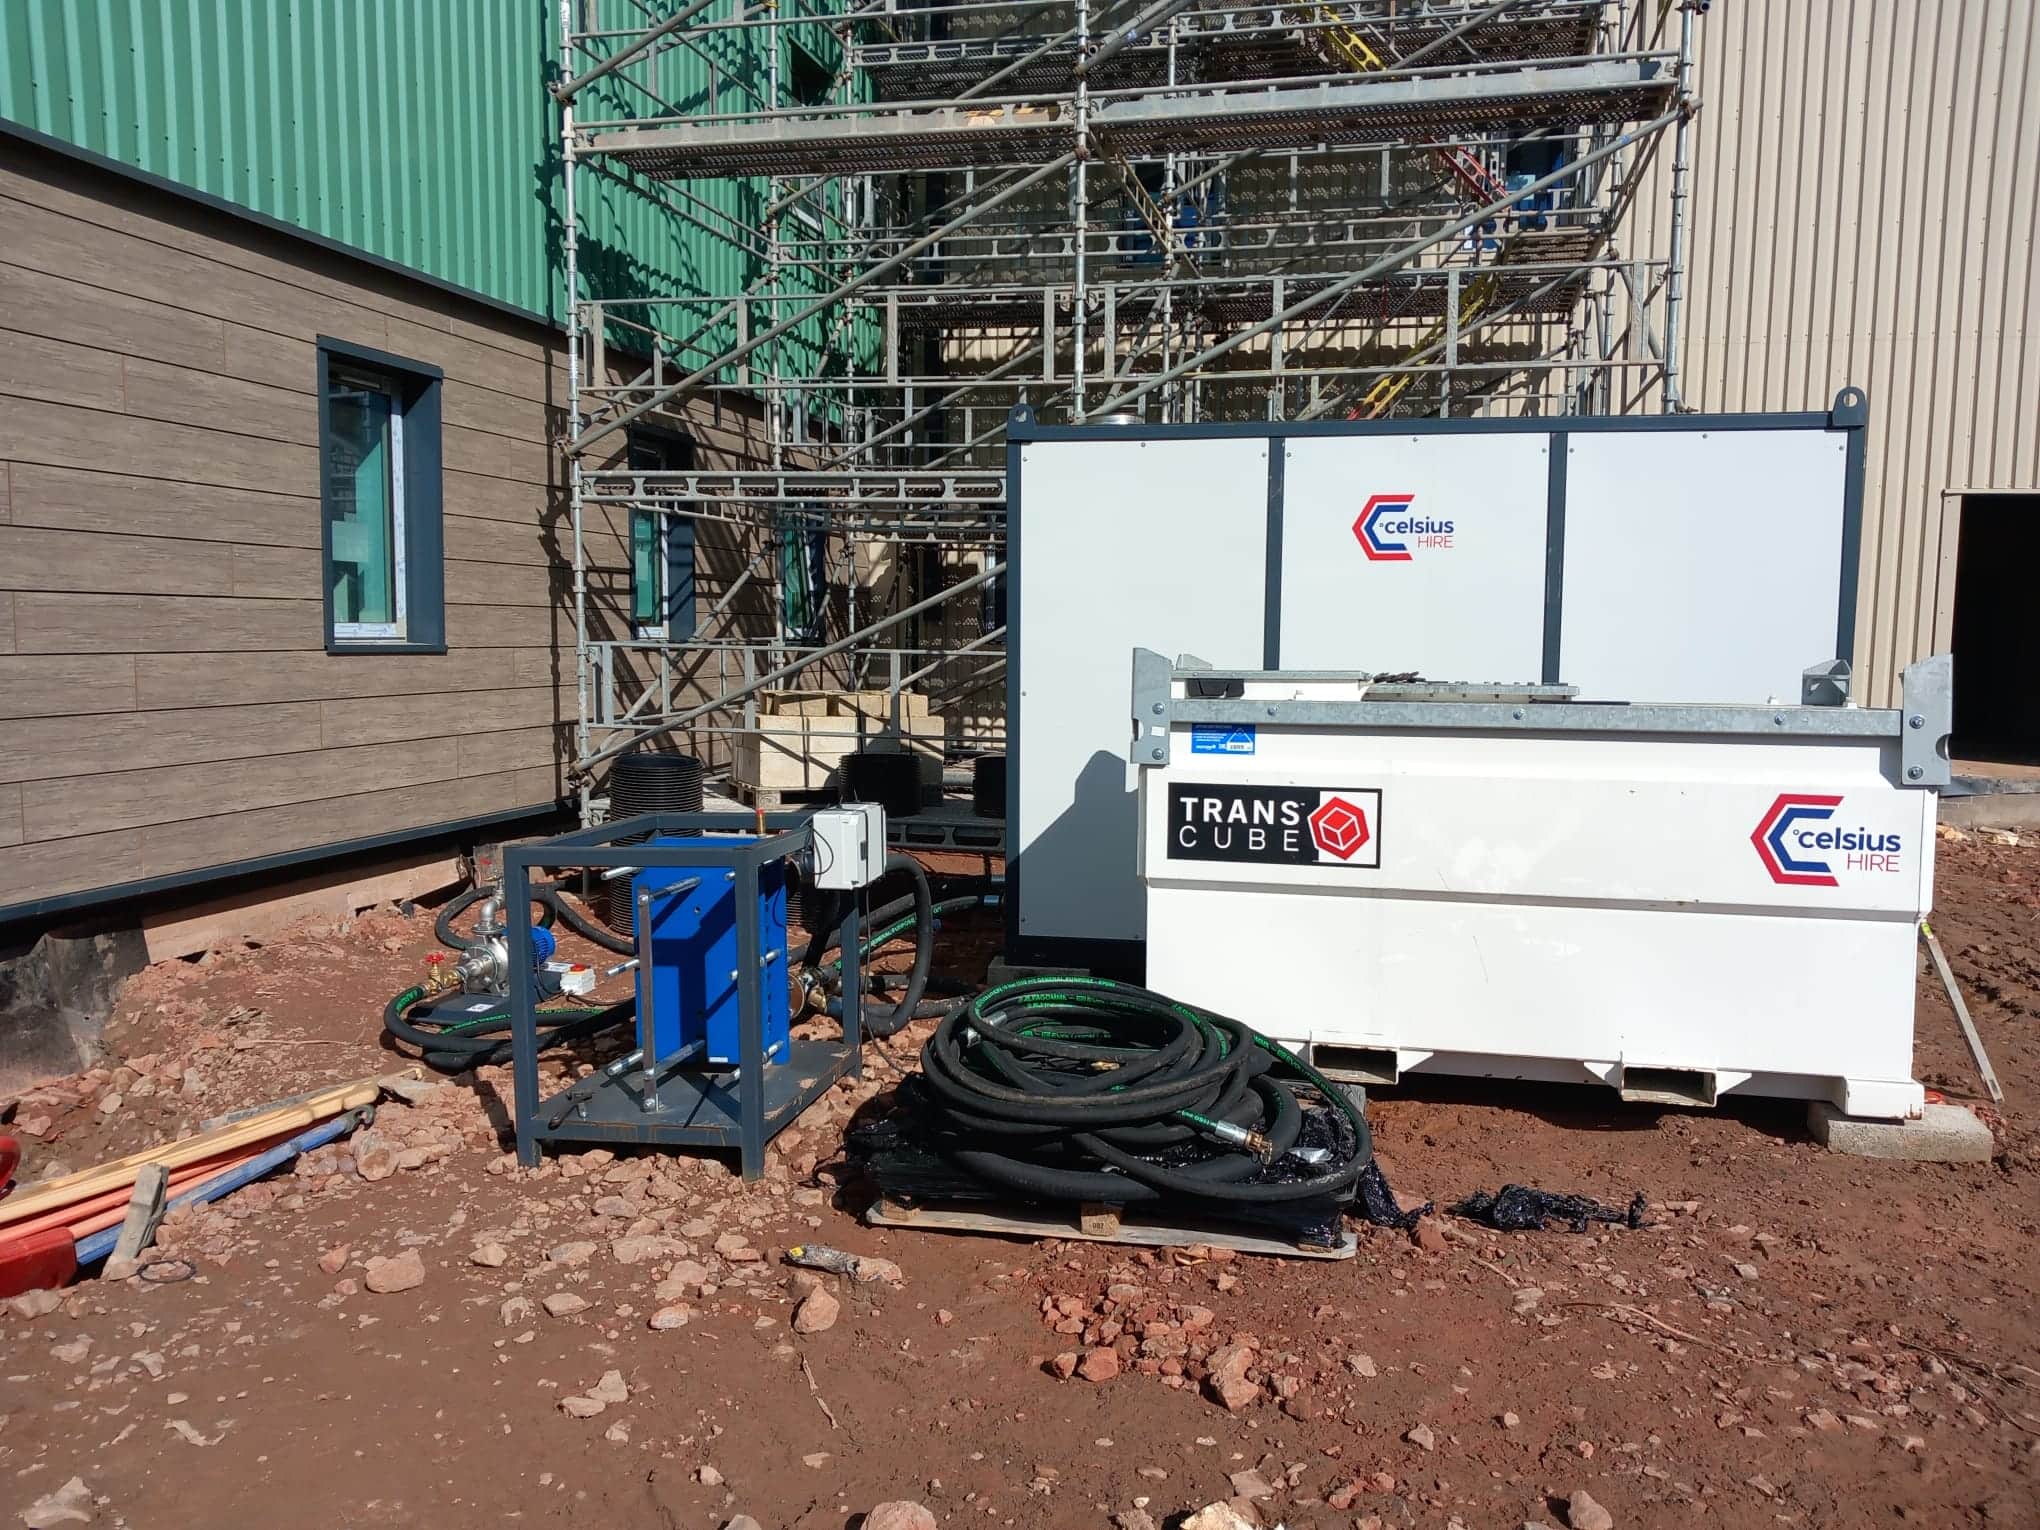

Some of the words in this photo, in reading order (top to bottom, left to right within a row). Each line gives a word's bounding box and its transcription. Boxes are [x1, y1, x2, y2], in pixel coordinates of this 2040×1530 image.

[1417, 535, 1455, 549] HIRE
[1179, 797, 1300, 825] TRANS
[1178, 826, 1300, 852] CUBE
[1847, 853, 1901, 873] HIRE
